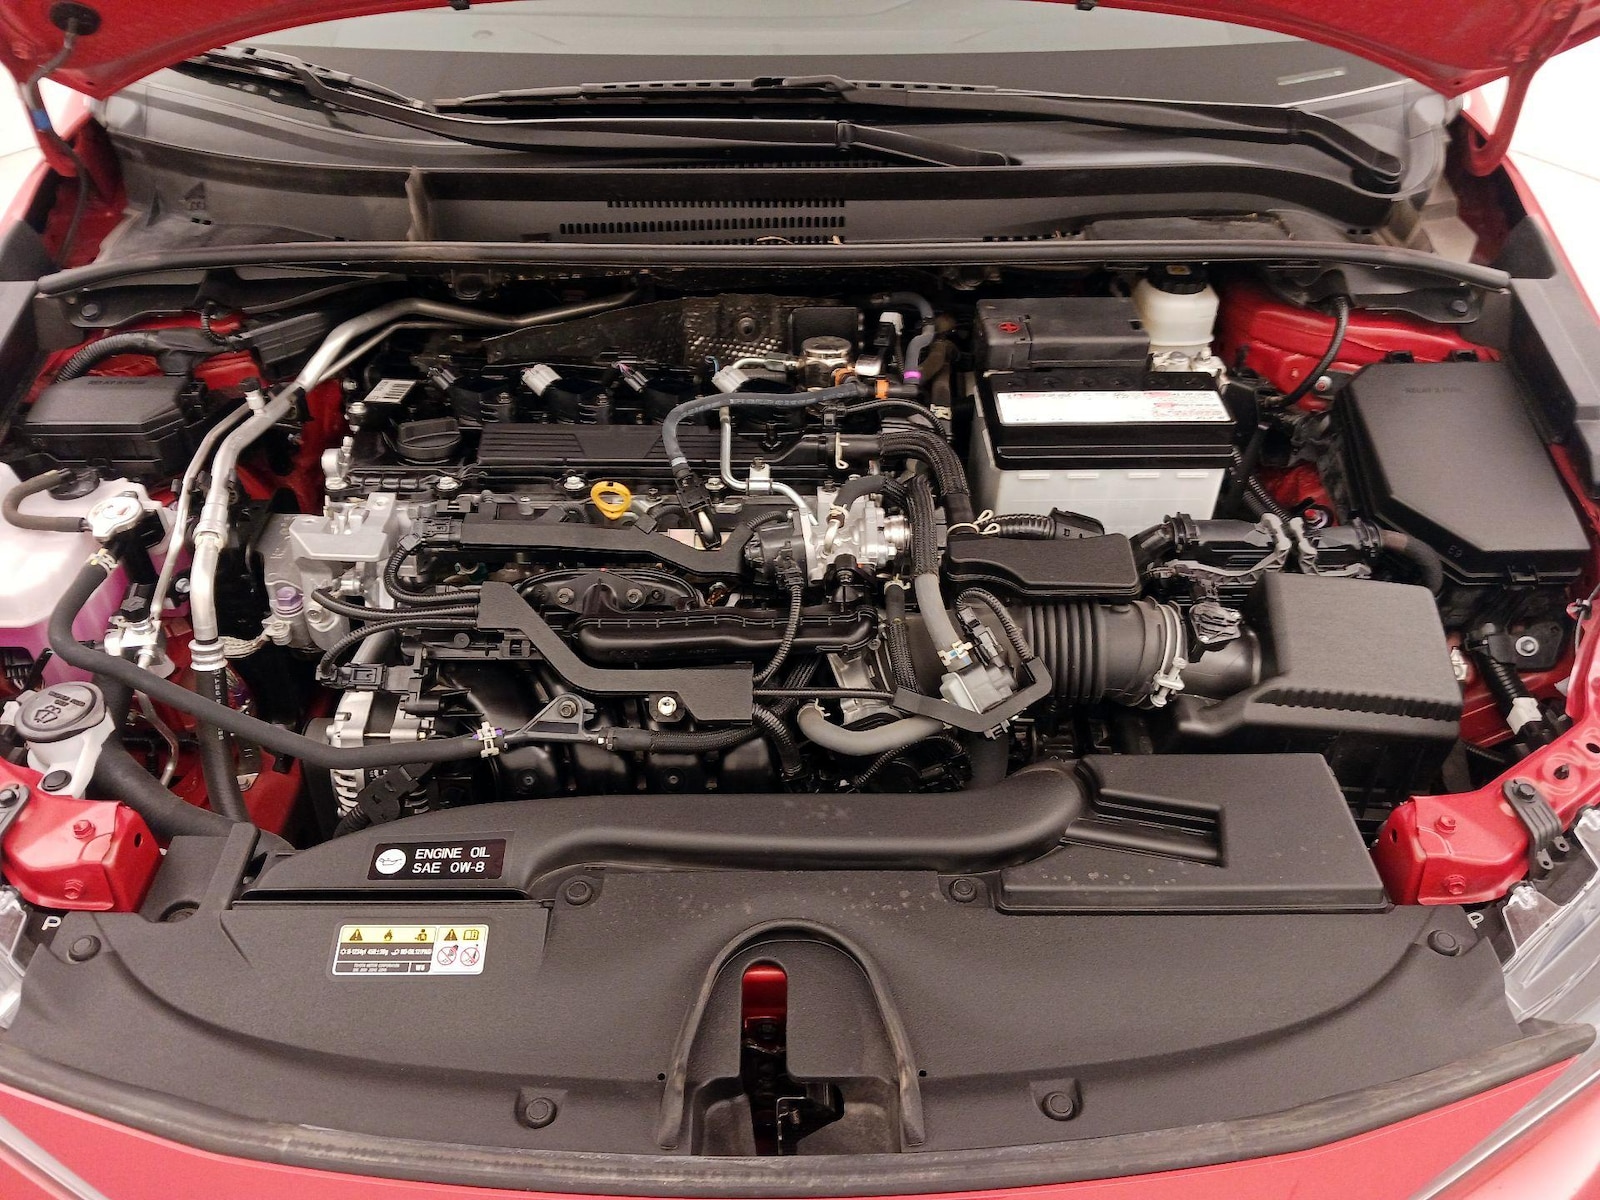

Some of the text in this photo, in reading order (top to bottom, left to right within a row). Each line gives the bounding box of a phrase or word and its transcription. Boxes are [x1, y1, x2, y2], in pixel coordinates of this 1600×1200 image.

[414, 846, 490, 860] ENGINE OIL
[411, 861, 485, 874] SAE 0W-8
[41, 915, 62, 931] P
[1467, 912, 1485, 929] P
